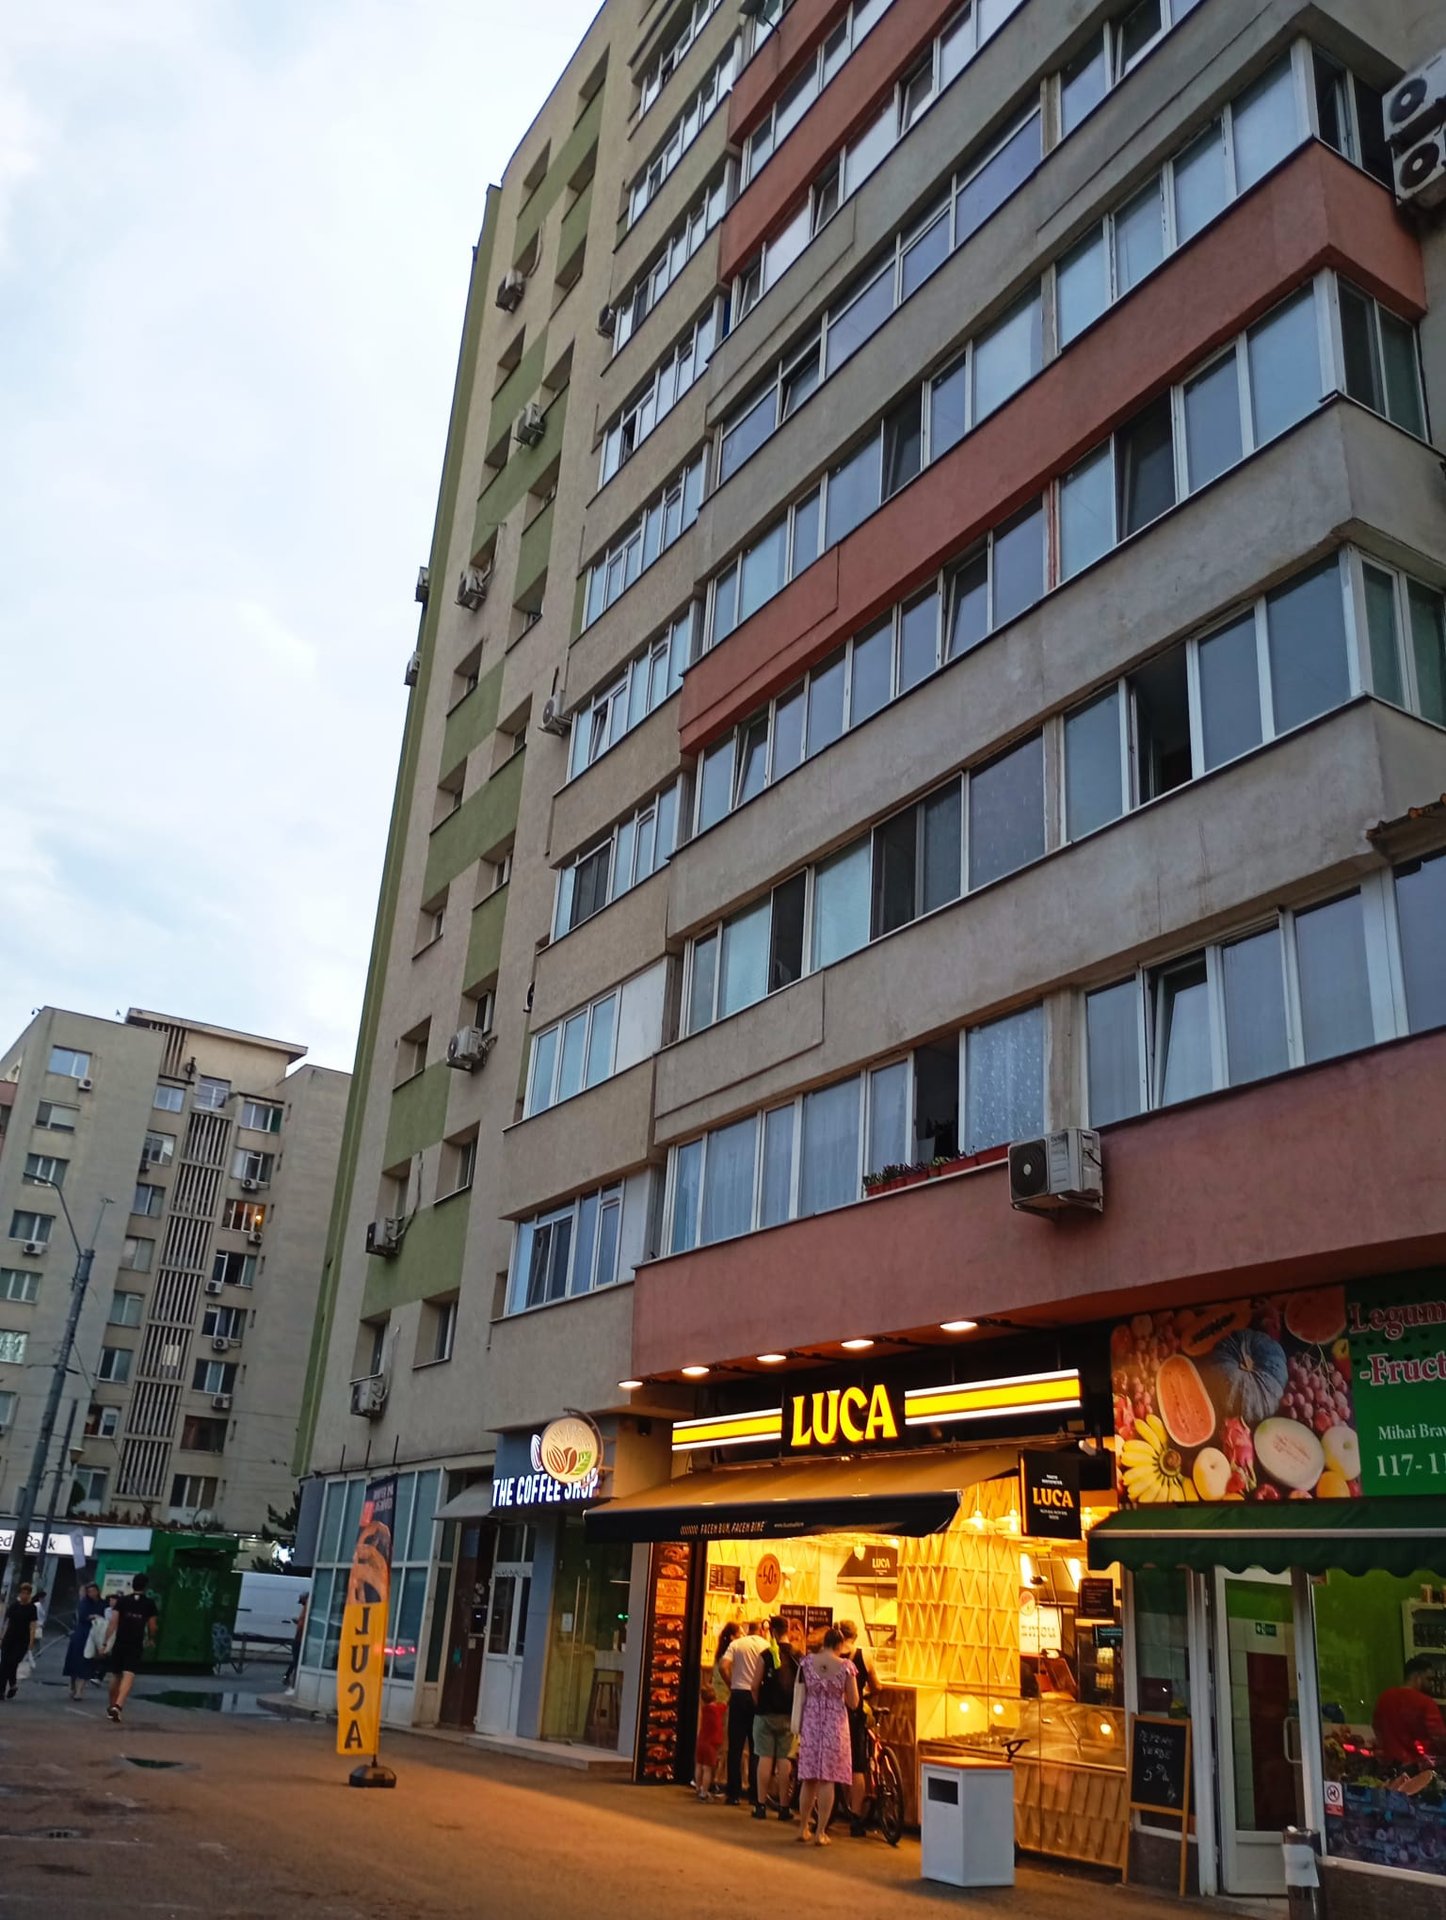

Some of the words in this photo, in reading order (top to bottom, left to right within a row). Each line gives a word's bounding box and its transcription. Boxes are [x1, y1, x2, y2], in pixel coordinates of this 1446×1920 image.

[791, 1384, 898, 1446] LUCA
[1378, 1424, 1416, 1440] Mihai
[492, 1478, 515, 1507] THE
[516, 1473, 561, 1505] COFFEE
[1032, 1487, 1074, 1508] LUCA
[25, 1535, 56, 1551] Bak
